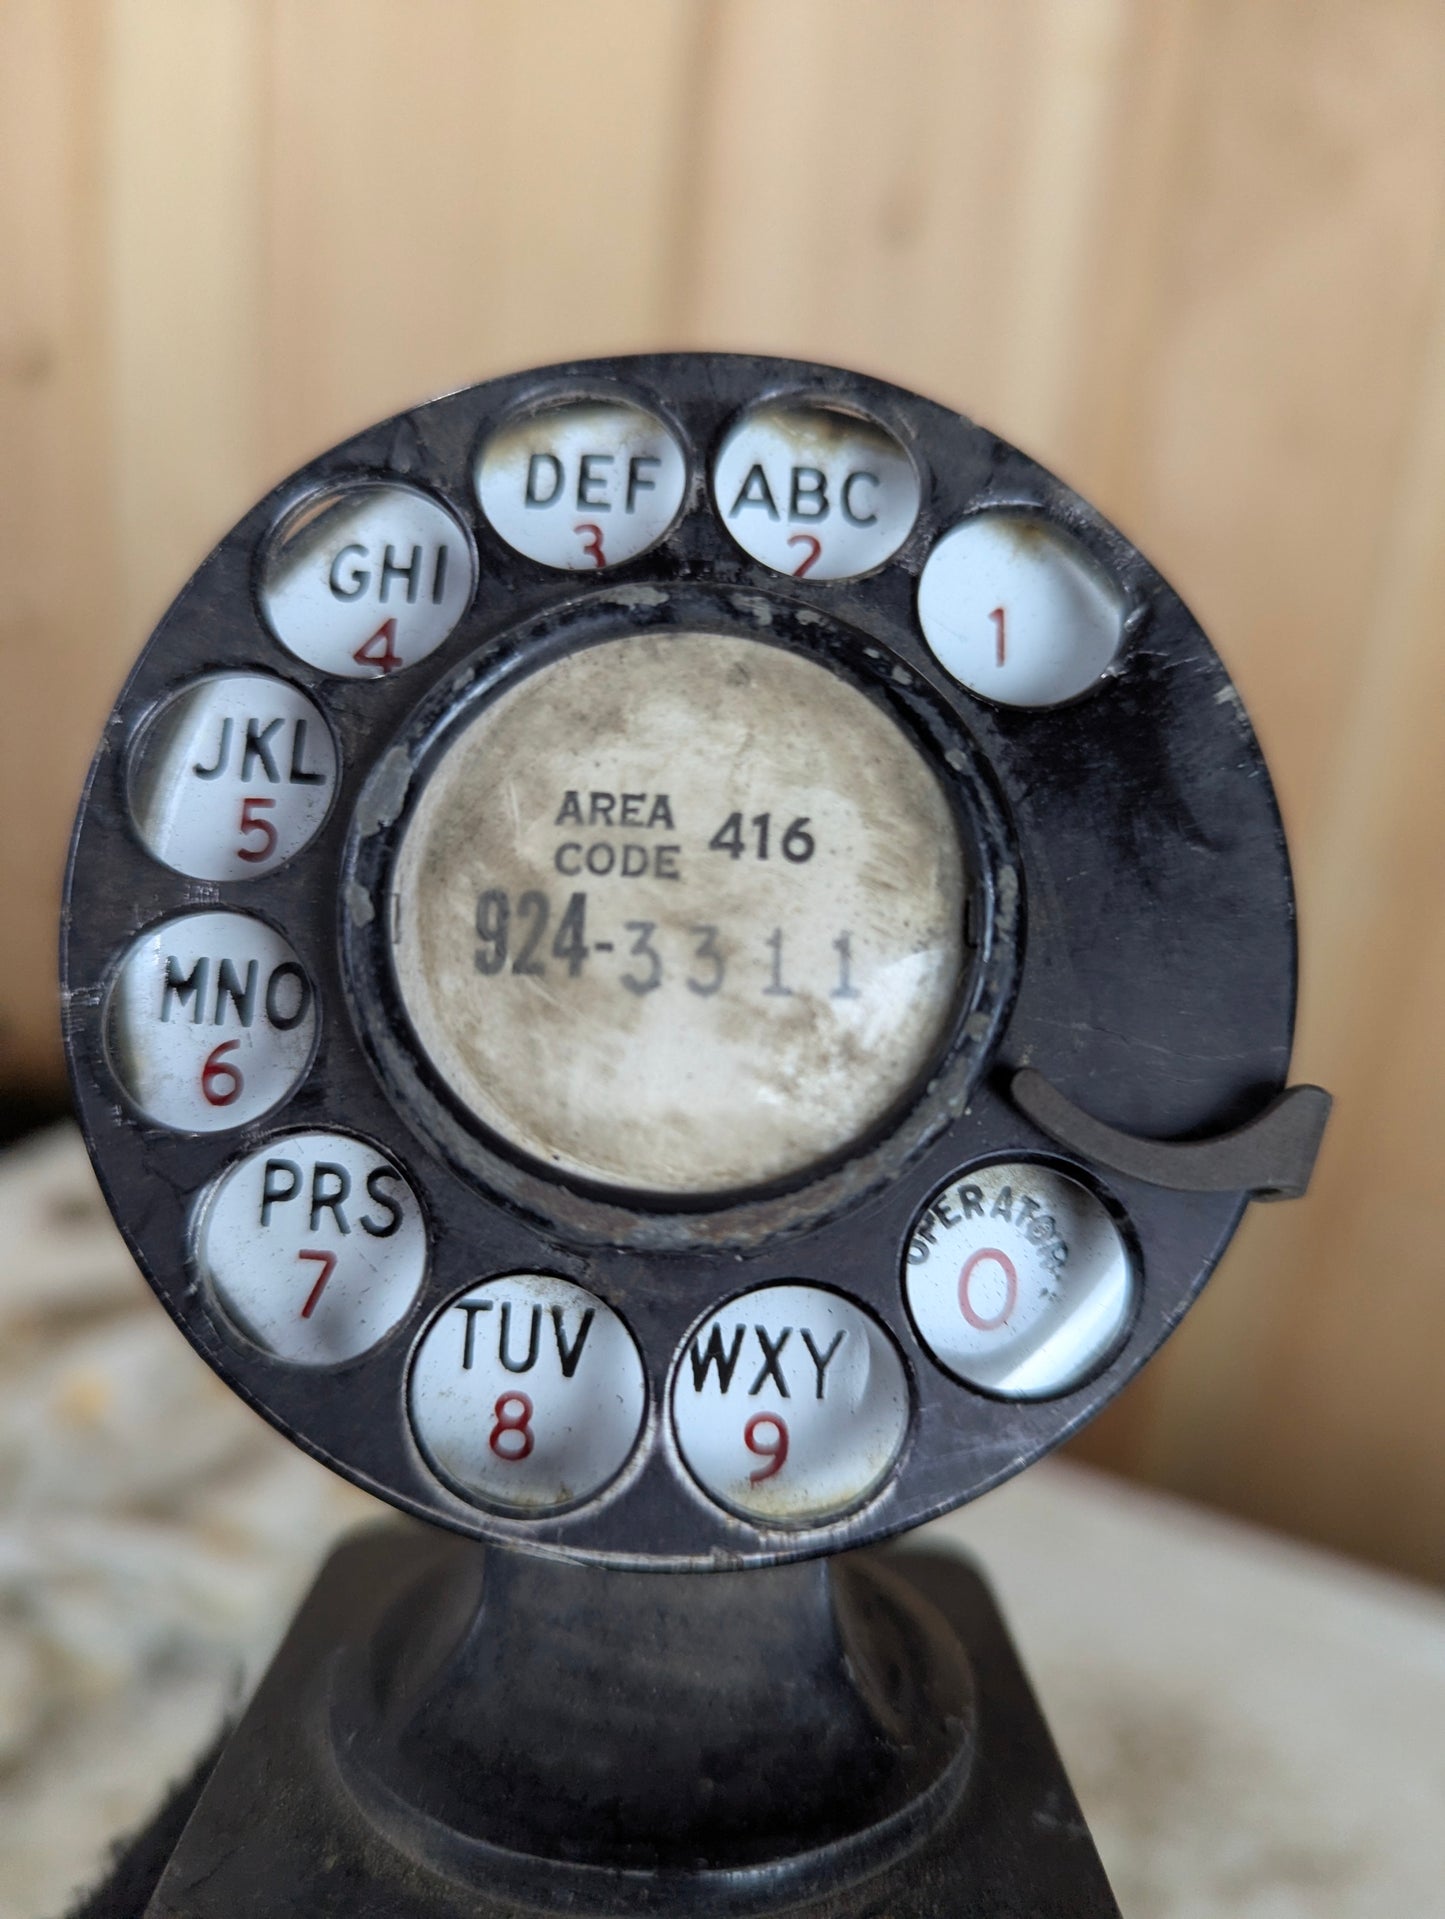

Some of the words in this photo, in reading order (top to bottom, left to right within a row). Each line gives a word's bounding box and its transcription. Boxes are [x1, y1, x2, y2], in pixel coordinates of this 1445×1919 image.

[524, 453, 661, 514] DEF
[728, 464, 880, 528] ABC
[329, 543, 449, 605] GHI
[352, 618, 403, 673] 4
[988, 606, 1005, 667] 1
[192, 717, 326, 785] JKL
[237, 797, 279, 863] 5
[554, 790, 676, 830] AREA
[554, 842, 682, 880] CODE
[709, 812, 816, 864] 416
[161, 955, 310, 1031] MNO
[201, 1039, 244, 1106] 6
[260, 1158, 402, 1238] PRS
[298, 1249, 338, 1318] 7
[957, 1247, 1018, 1332] 0
[453, 1299, 597, 1378] TUV
[690, 1322, 849, 1400] WXY
[489, 1390, 535, 1461] 8
[744, 1412, 790, 1485] 9
